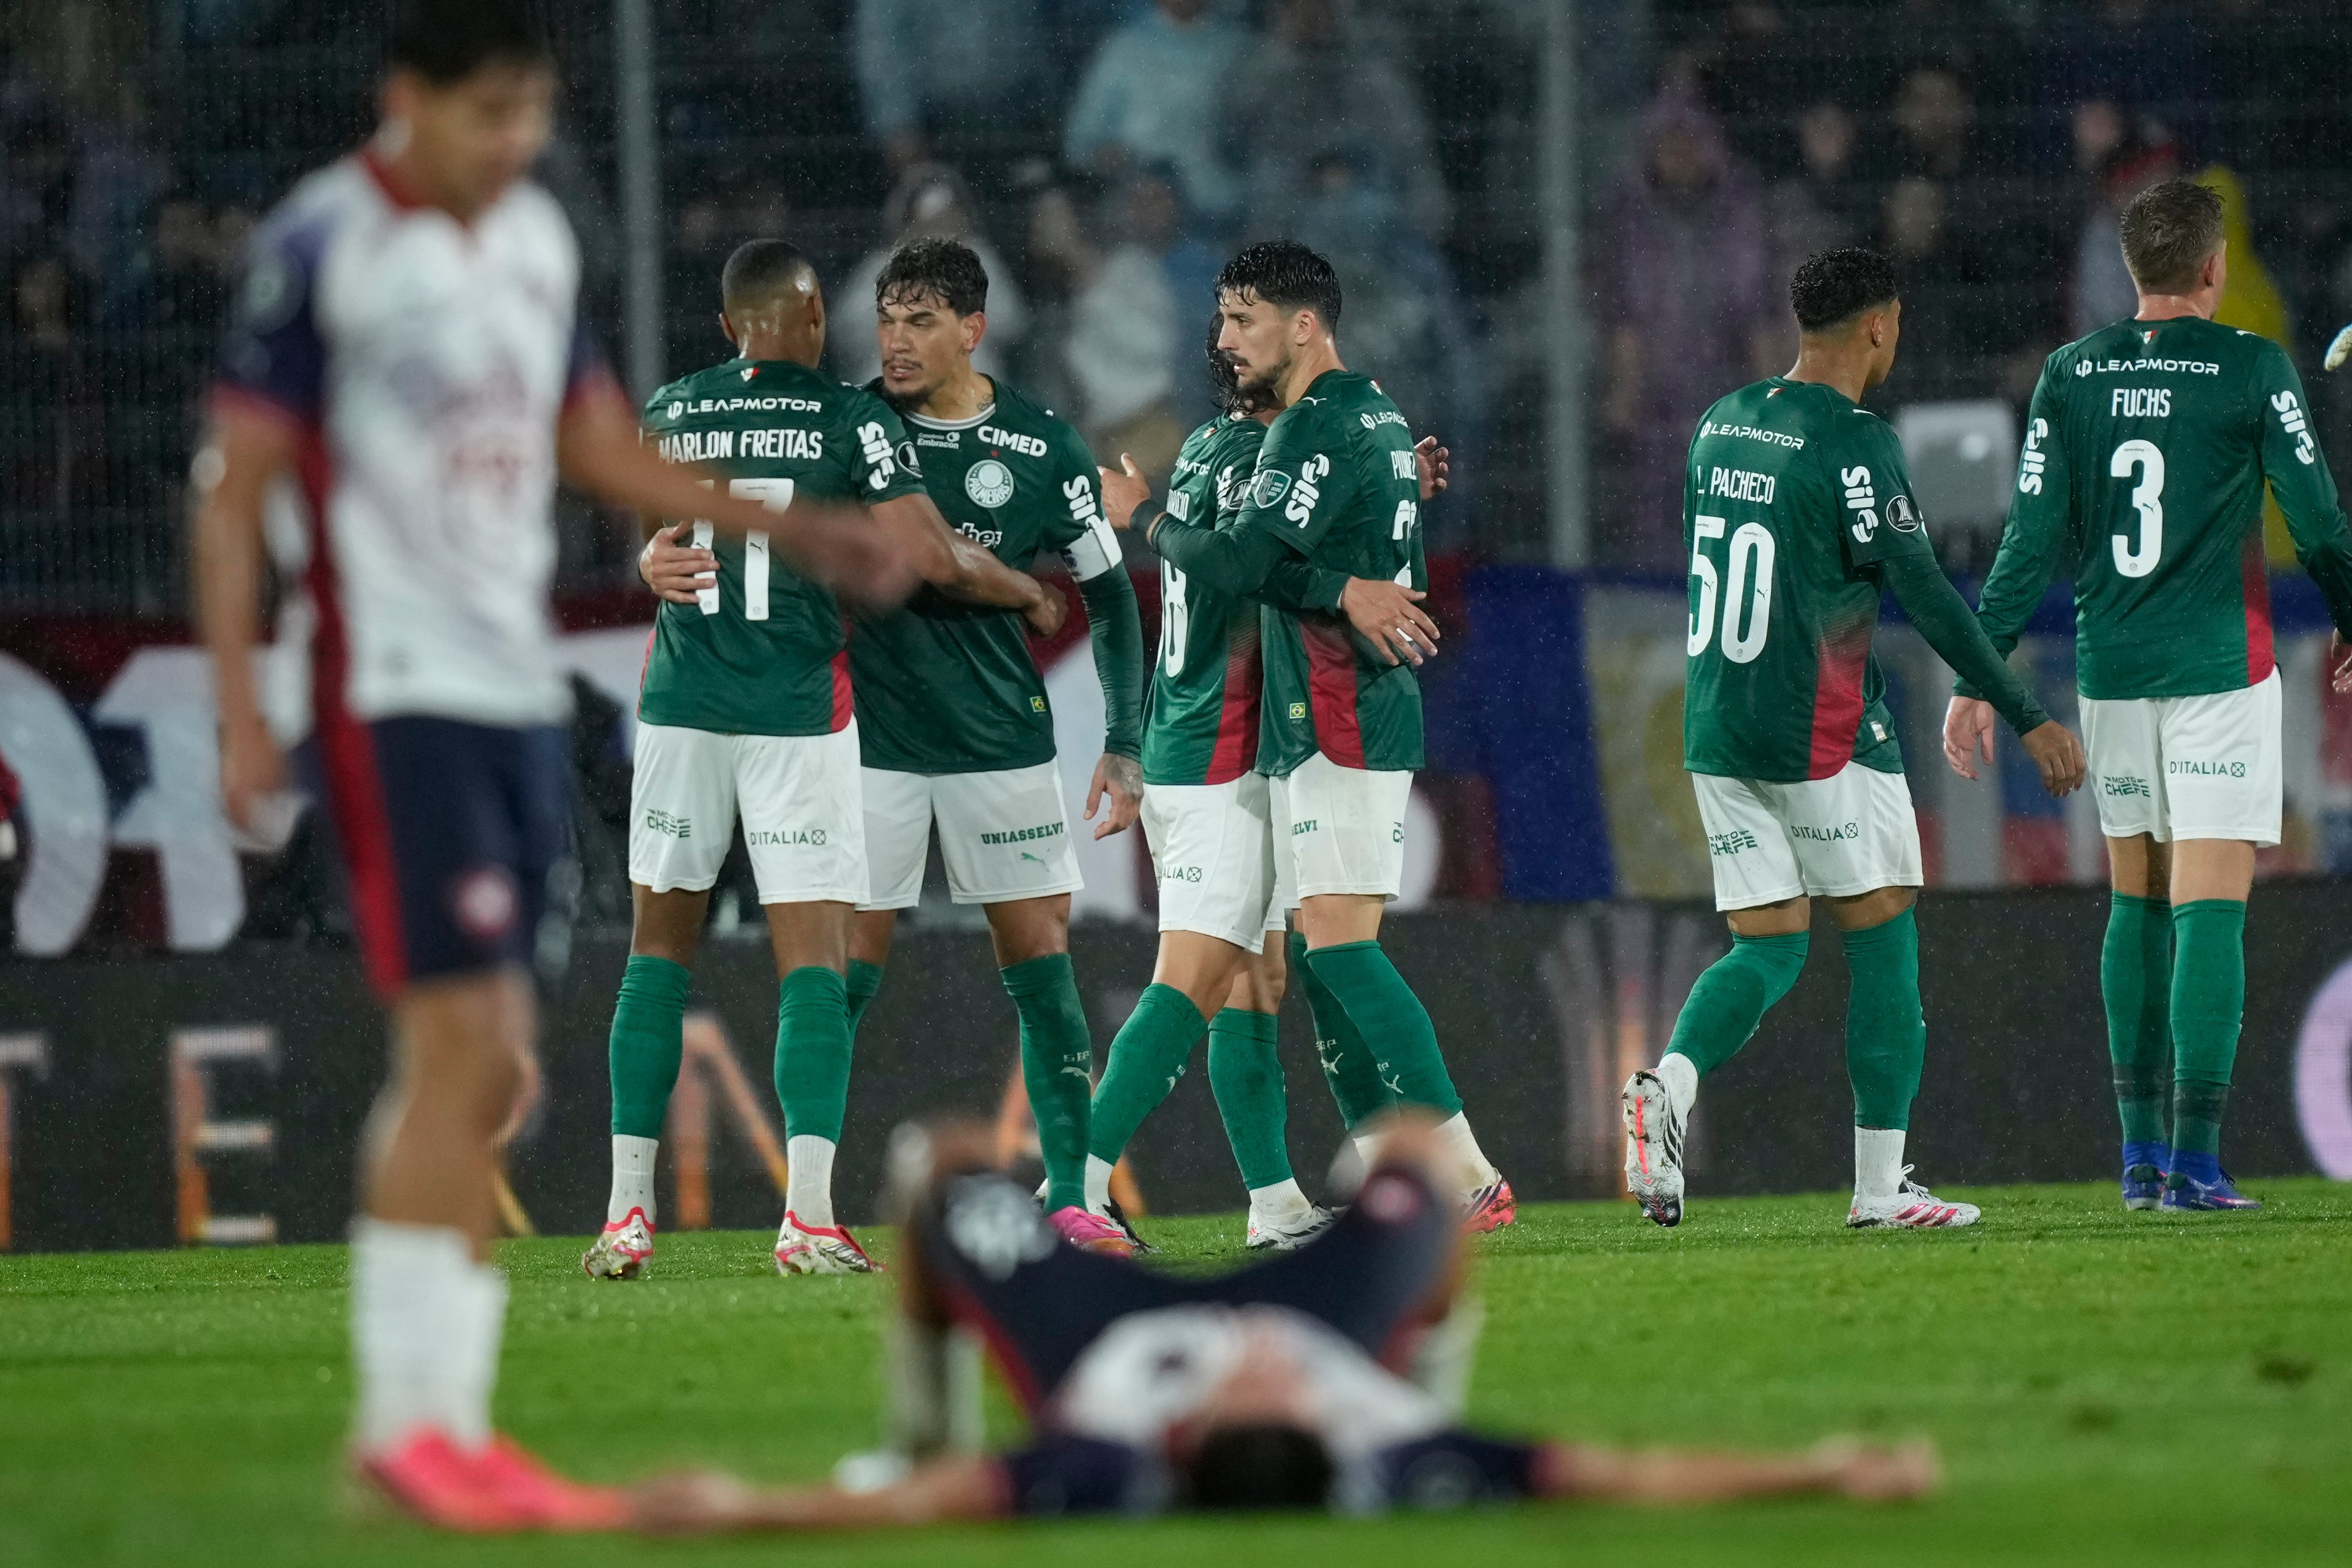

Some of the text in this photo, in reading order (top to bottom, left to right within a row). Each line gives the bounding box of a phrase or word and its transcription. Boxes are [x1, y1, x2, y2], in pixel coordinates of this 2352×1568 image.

[2097, 359, 2219, 375] LEAPMOTOR
[687, 398, 822, 413] LEAPMOTOR
[2111, 388, 2172, 417] FUCHS
[658, 429, 823, 464] MARLON FREITAS
[917, 438, 959, 449] Embracon
[977, 425, 1047, 457] CIMED
[1710, 424, 1804, 450] LEAPMOTOR
[969, 477, 1010, 504] PALMEIRAS
[1710, 466, 1775, 504] PACHECO
[2111, 439, 2164, 578] 3
[1687, 515, 1775, 664] 50
[2170, 761, 2228, 775] D'ITALIA
[750, 832, 809, 845] D'ITALIA
[981, 821, 1063, 844] UNIASSELVI
[1791, 826, 1844, 841] D'ITALIA
